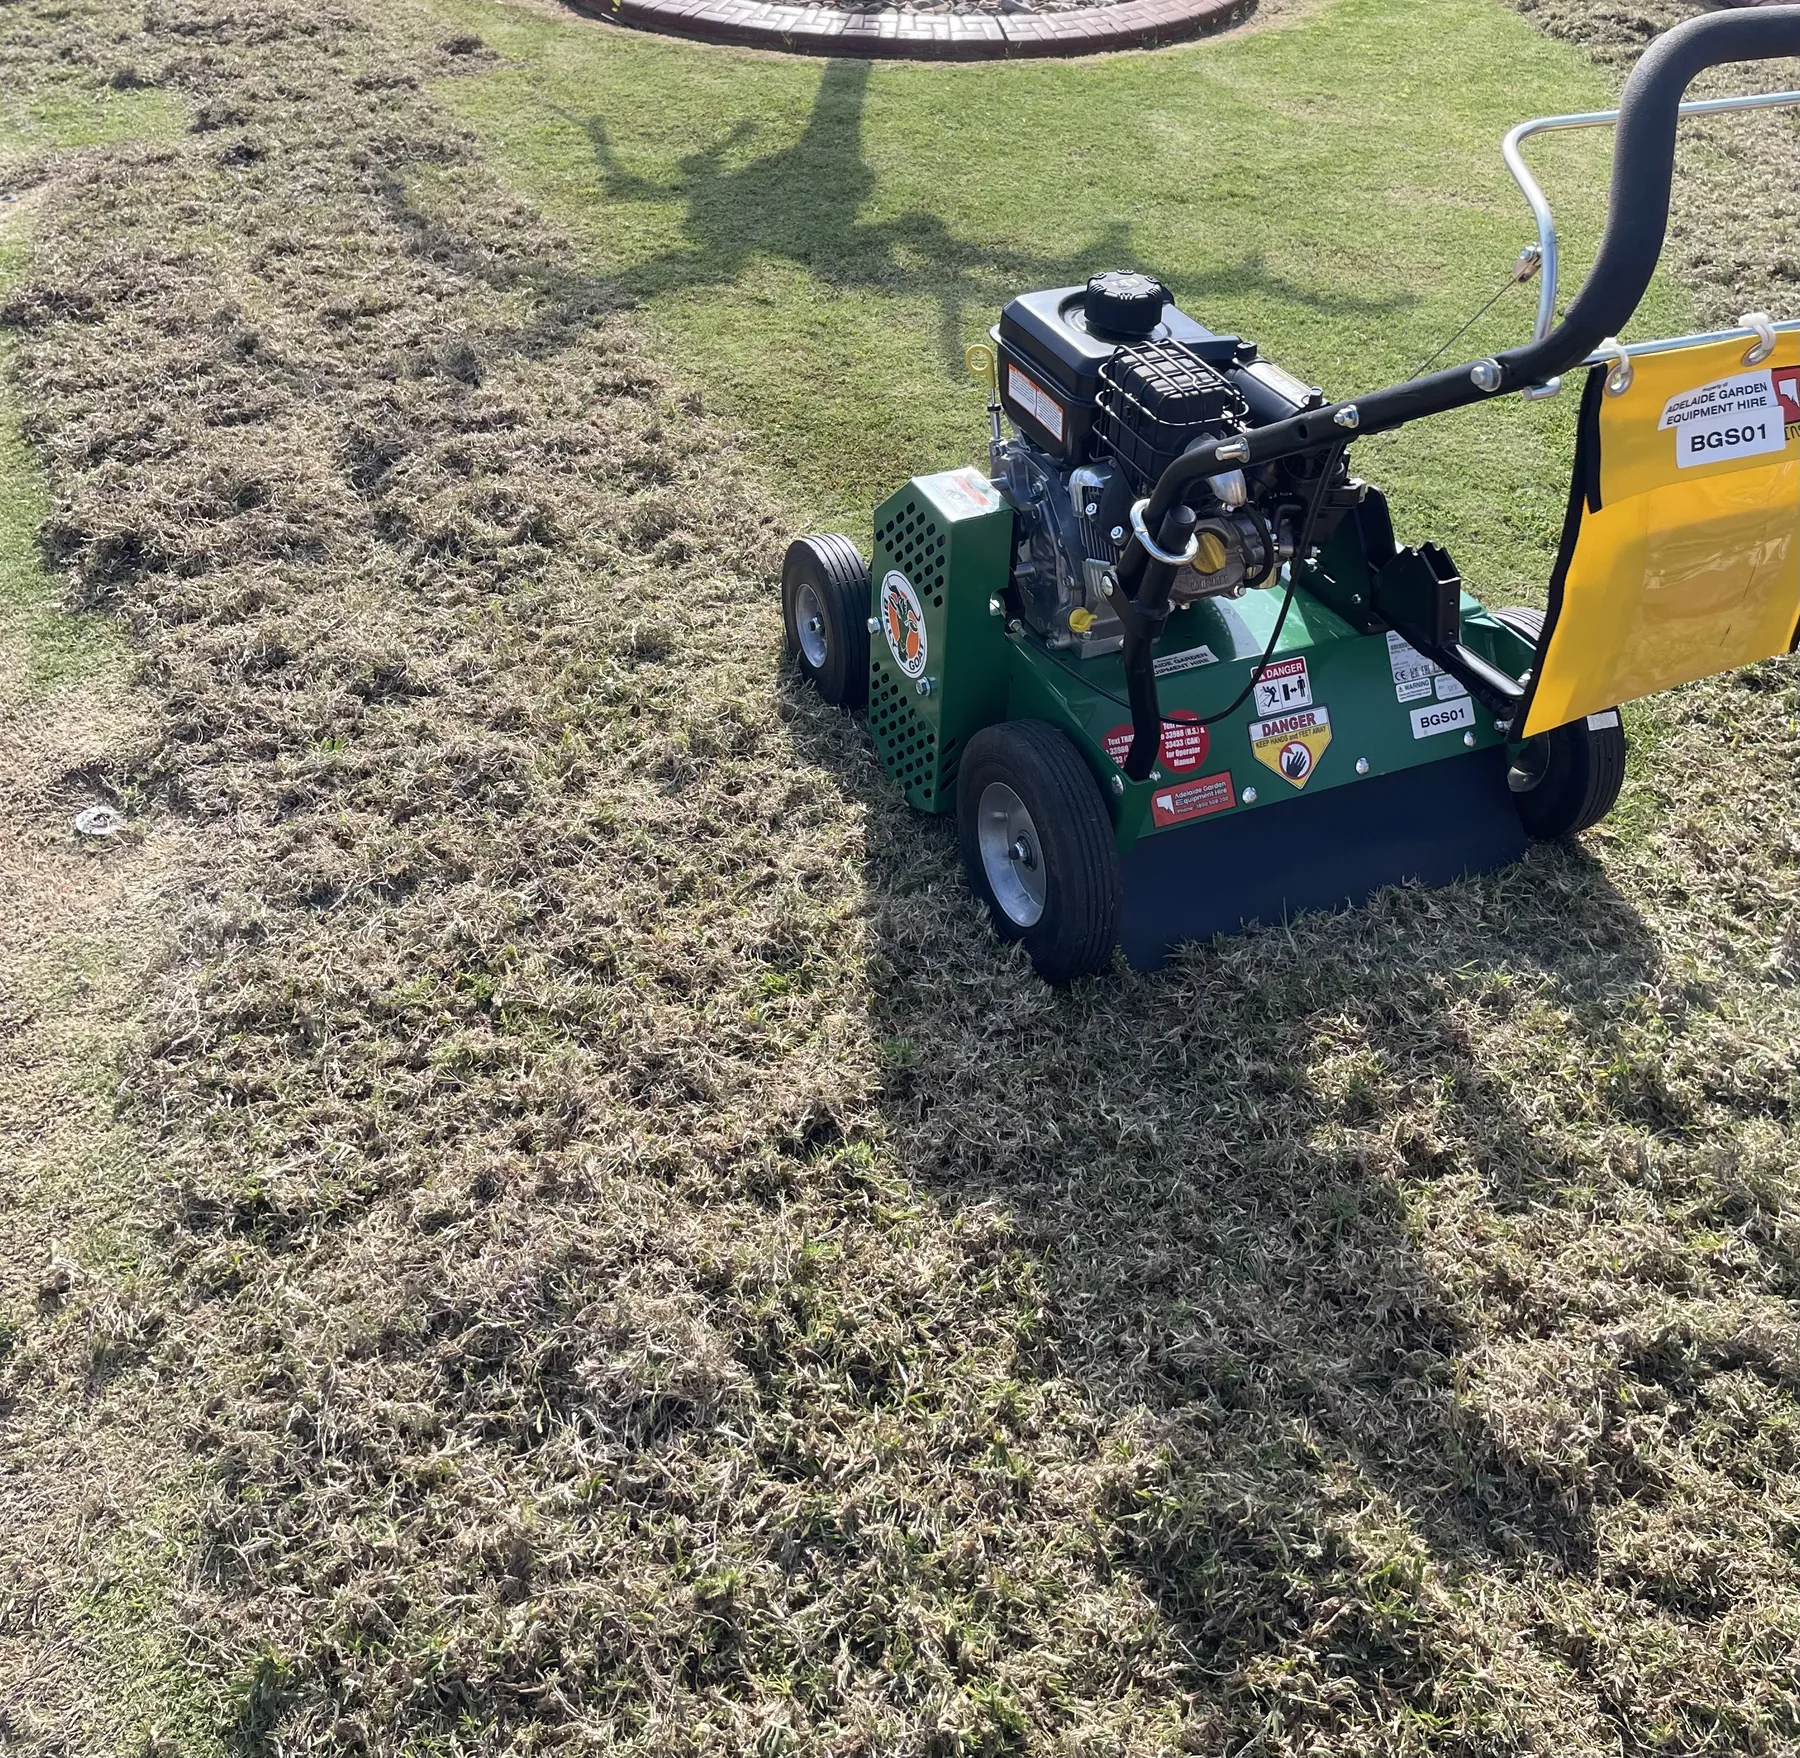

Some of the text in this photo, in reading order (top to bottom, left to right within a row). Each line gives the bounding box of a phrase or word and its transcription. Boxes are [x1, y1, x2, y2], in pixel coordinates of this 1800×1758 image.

[1665, 382, 1768, 415] ADELAIDE GARDEN
[1666, 396, 1768, 425] EQUIPMENT HIRE
[1690, 423, 1767, 452] BGS01
[908, 640, 924, 671] GOAT
[1173, 652, 1209, 664] GARDEN
[1189, 658, 1210, 666] HIRE
[1266, 662, 1303, 679] DANGER
[1403, 679, 1430, 691] WARNING
[1261, 712, 1317, 738] DANGER
[1420, 708, 1465, 728] BGS01
[1199, 726, 1206, 734] &
[1255, 726, 1326, 749] KEEP HANDS and FEET AWAY
[1173, 755, 1196, 767] Manual
[1174, 746, 1201, 758] Operator
[1174, 781, 1227, 800] Adelaide Garden
[1175, 787, 1228, 807] Equipment Hire
